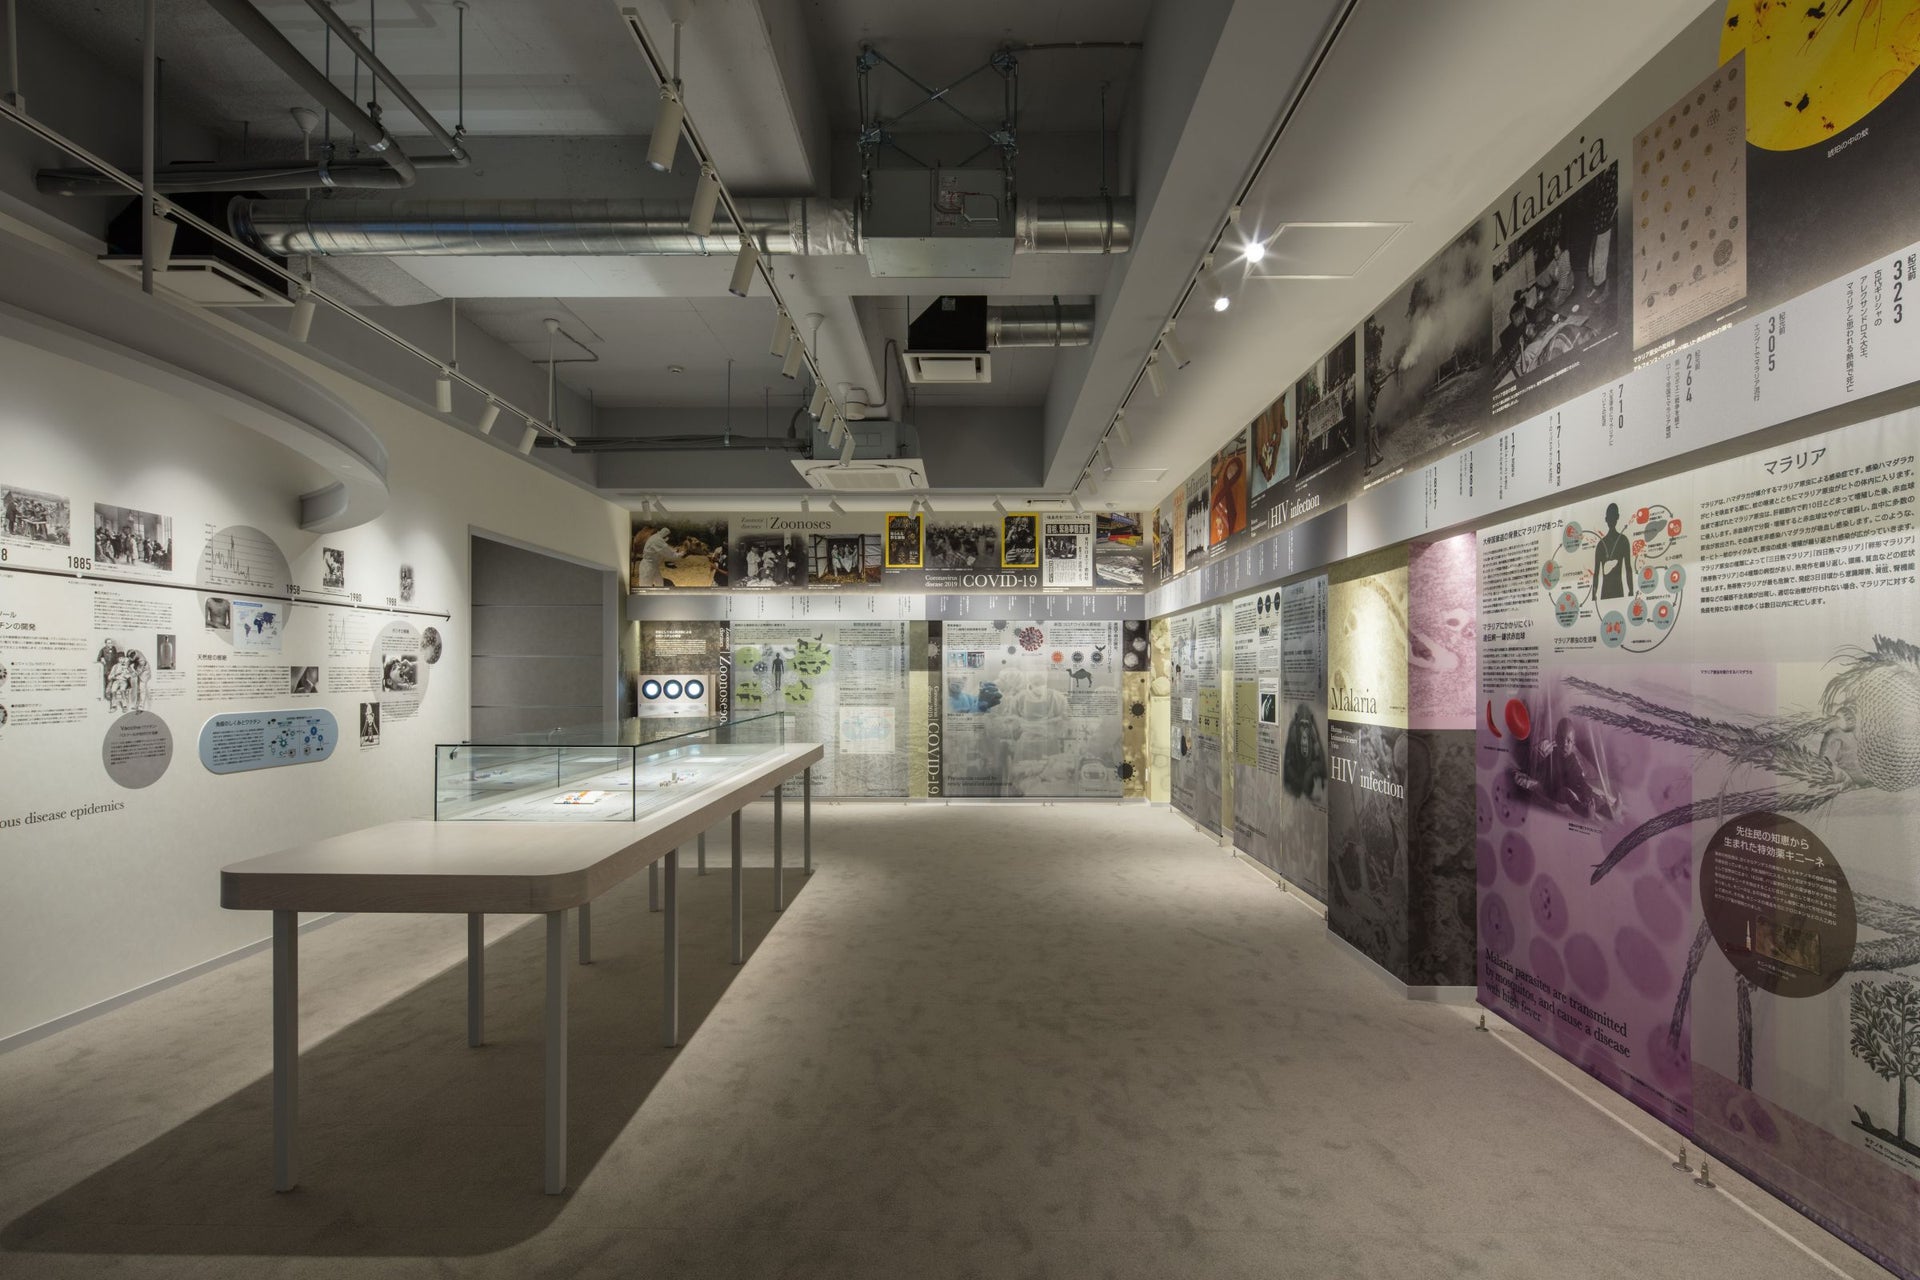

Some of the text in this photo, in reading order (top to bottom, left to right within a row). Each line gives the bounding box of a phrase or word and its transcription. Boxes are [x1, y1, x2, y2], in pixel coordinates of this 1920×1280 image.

[1492, 136, 1608, 251] Malaria
[1874, 269, 1883, 327] 古代ギリシャの
[1893, 260, 1903, 324] 323
[1768, 316, 1776, 372] 305
[1764, 448, 1826, 475] マラリア
[770, 516, 832, 530] Zoonoses
[1271, 500, 1289, 528] HIV
[1291, 492, 1320, 518] infection
[1, 548, 8, 561] 8
[67, 556, 91, 570] 1885
[286, 584, 300, 595] 1958
[963, 574, 1038, 588] COVID-19
[1331, 687, 1378, 714] Malaria
[927, 722, 940, 794] COVID-19
[1331, 755, 1404, 799] HIV infection
[25, 811, 67, 825] disease
[70, 800, 125, 820] epidemics
[1724, 836, 1825, 868] 生まれた特効薬キニーネ
[1736, 826, 1809, 850] 先住民の知恵から
[1485, 948, 1627, 1037] Malaria parasites are transmitted
[1486, 981, 1541, 1022] with high fever
[1485, 963, 1494, 981] by
[1538, 996, 1555, 1014] and
[1557, 1008, 1583, 1031] cause
[1585, 1025, 1591, 1036] a
[1594, 1028, 1631, 1058] disease
